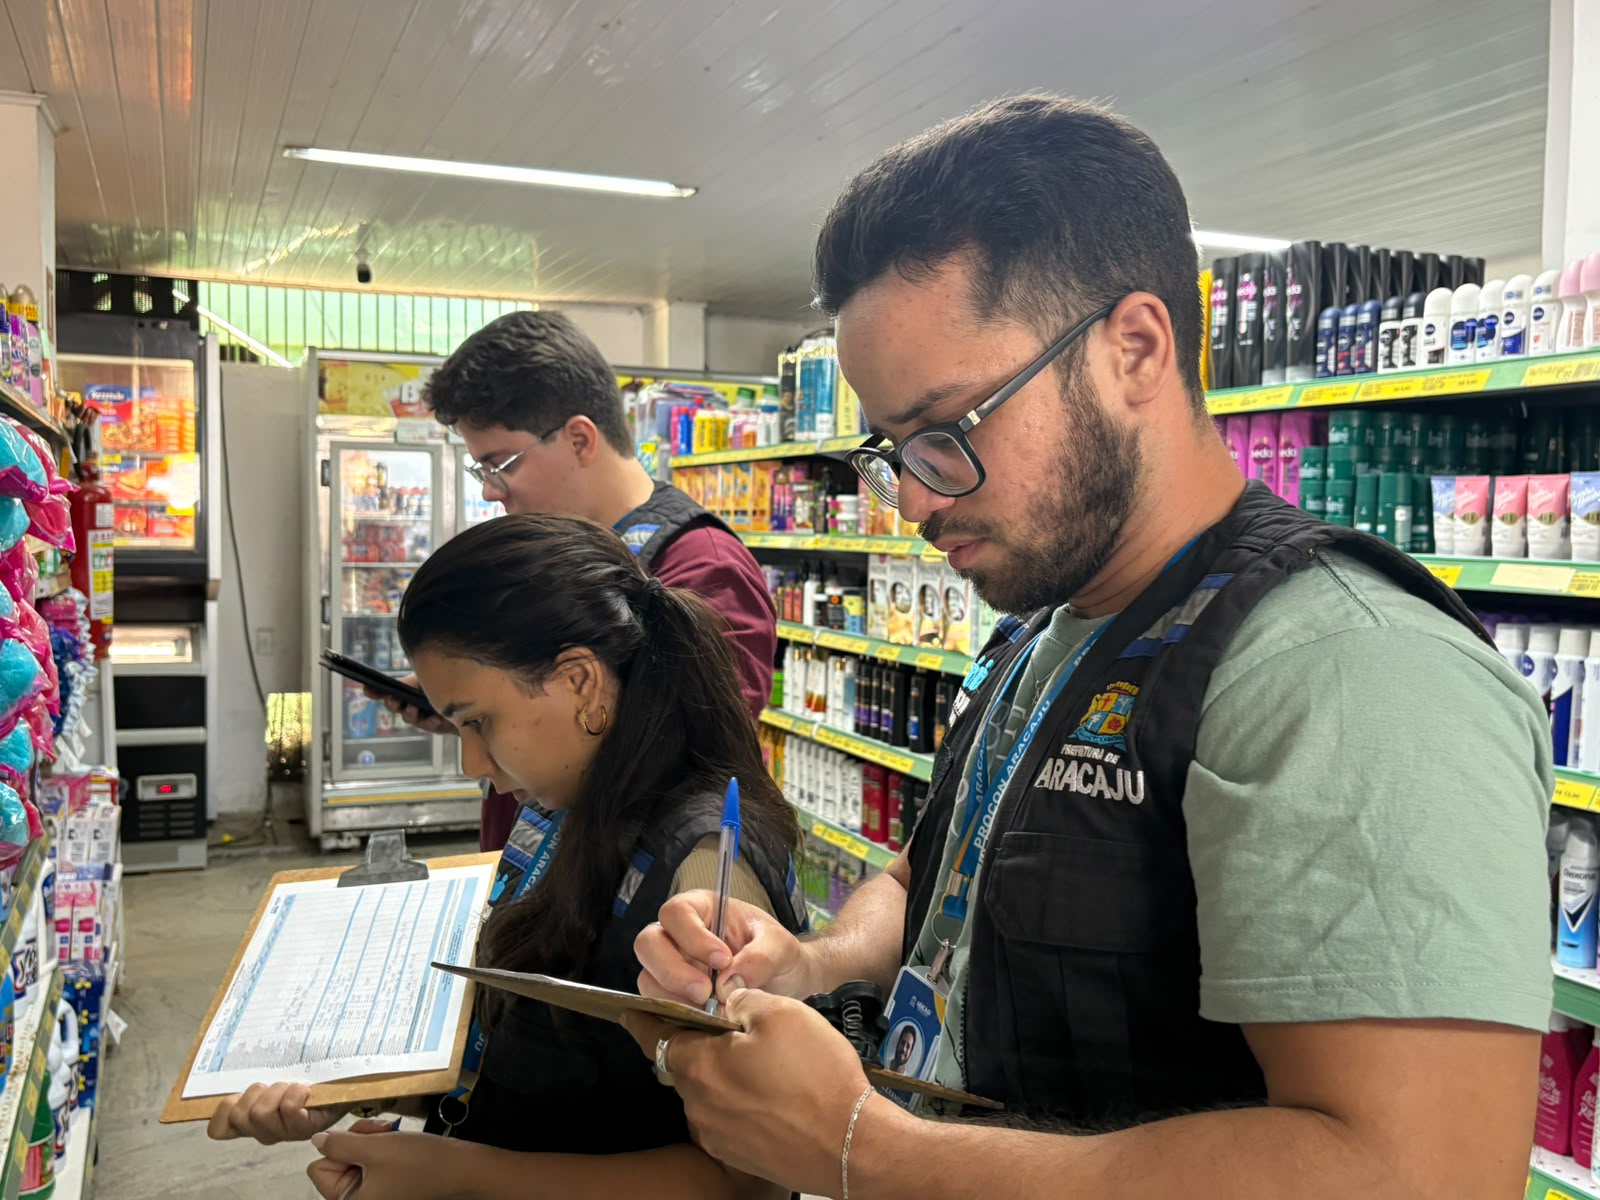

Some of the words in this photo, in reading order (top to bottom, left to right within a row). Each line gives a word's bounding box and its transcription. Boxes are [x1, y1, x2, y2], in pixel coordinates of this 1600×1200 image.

[1006, 700, 1051, 778] ARACAJU
[1104, 752, 1121, 765] DE
[1033, 757, 1145, 805] ARACAJU
